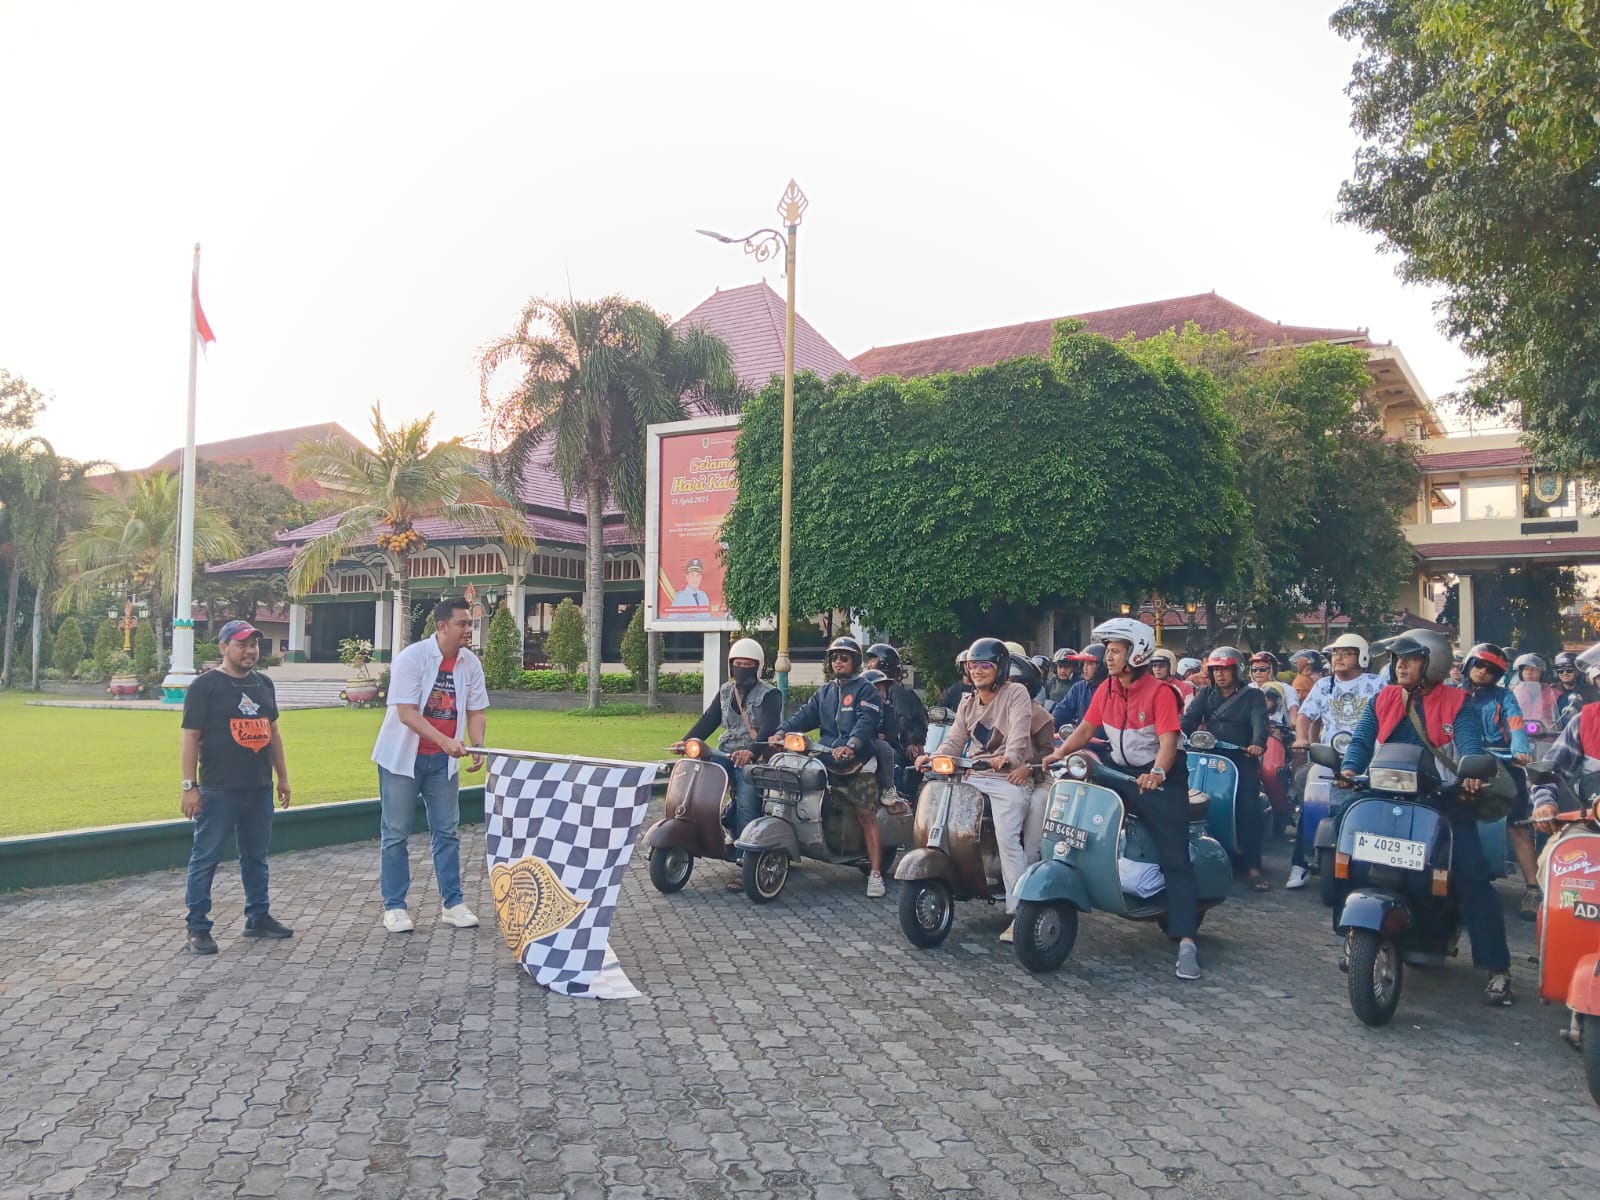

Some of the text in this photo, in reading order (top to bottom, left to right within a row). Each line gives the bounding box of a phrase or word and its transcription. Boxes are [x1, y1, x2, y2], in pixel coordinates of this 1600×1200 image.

[690, 456, 739, 473] Selama
[672, 474, 739, 494] Hari Kar
[1045, 821, 1087, 841] AD 6464 HL
[1358, 836, 1423, 856] A 4029 TS
[1574, 903, 1598, 919] AD
